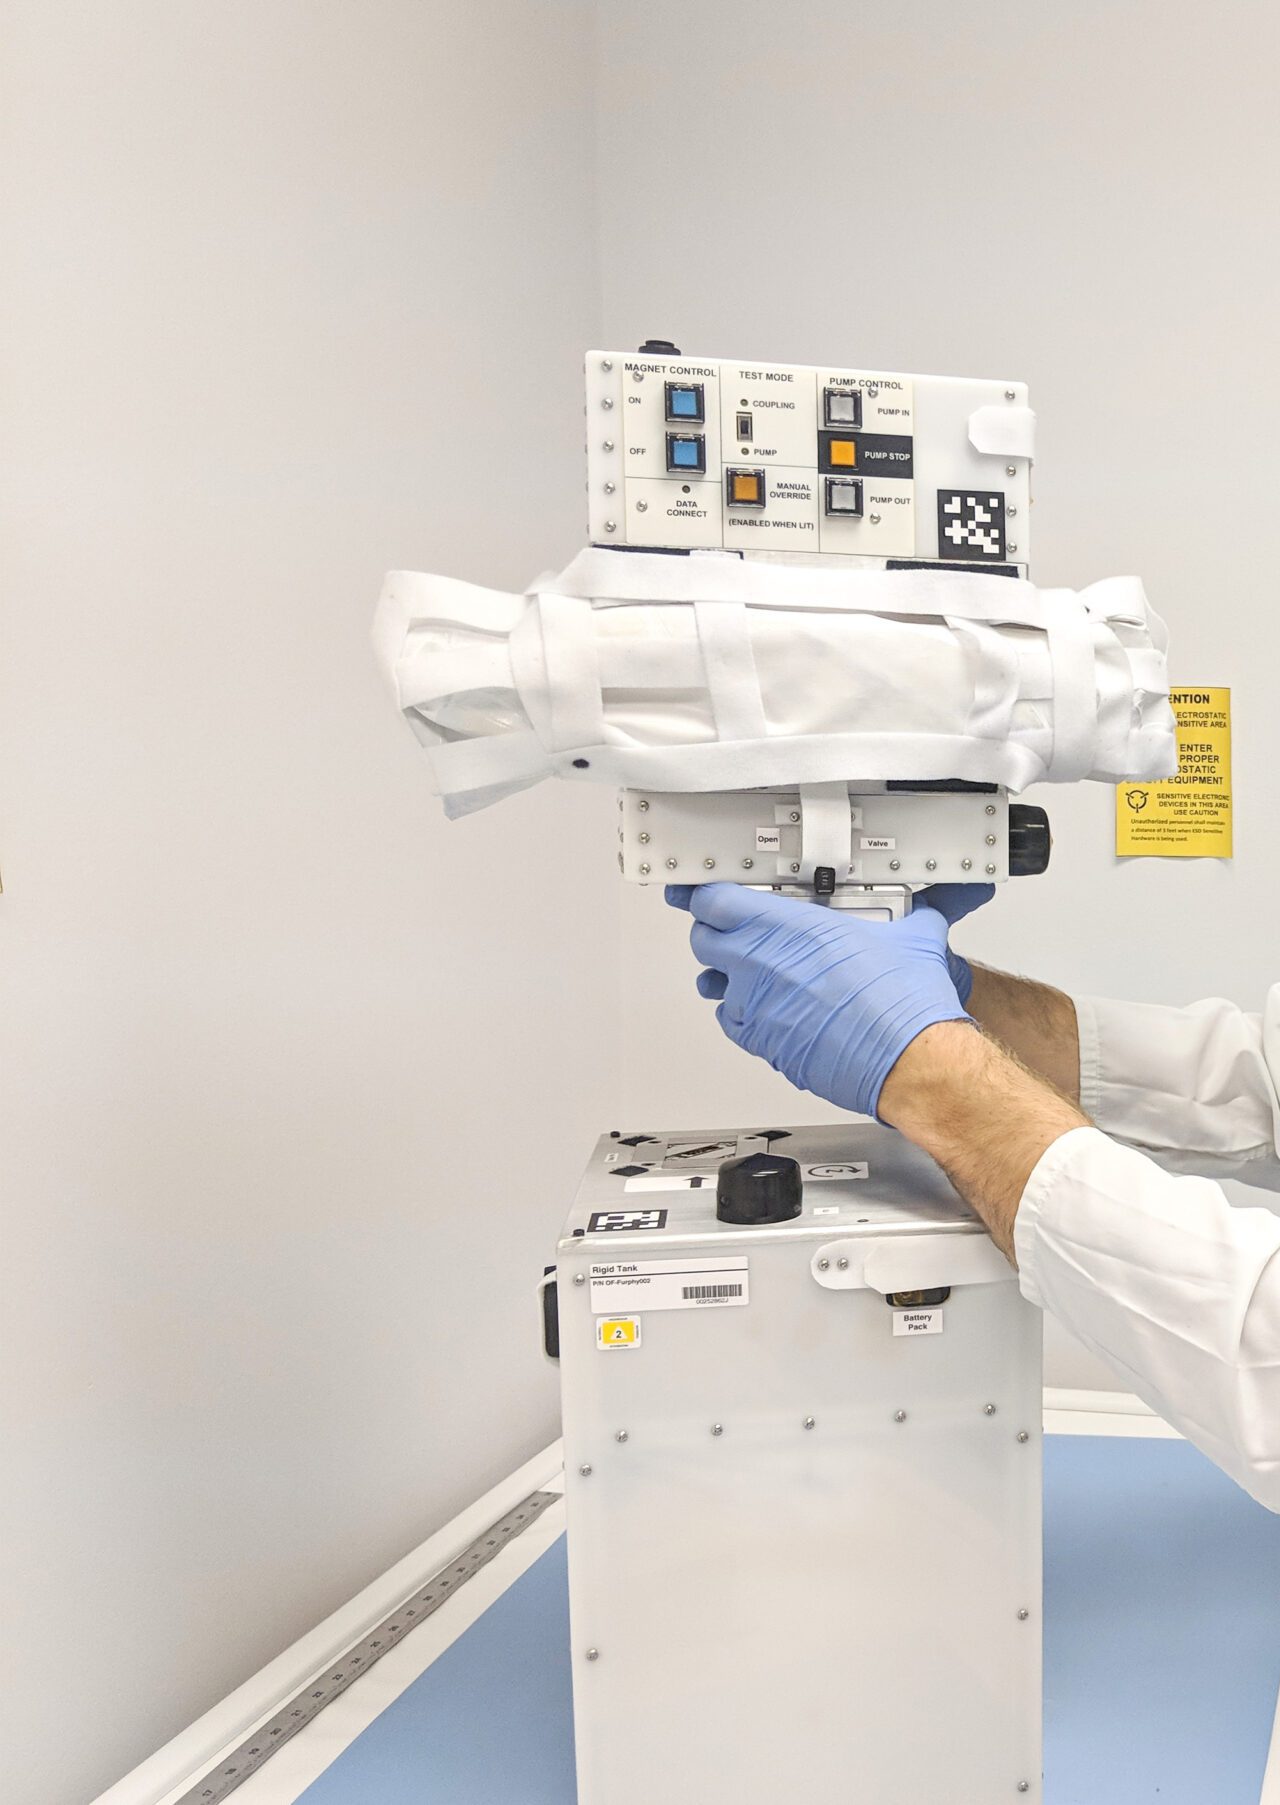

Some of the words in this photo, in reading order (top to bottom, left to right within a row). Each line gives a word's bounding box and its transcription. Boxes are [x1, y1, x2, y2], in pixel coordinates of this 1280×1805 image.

[624, 363, 666, 374] MAGNET
[669, 366, 717, 378] CONTROL
[739, 371, 762, 380] TEST
[766, 373, 794, 382] MODE
[829, 377, 856, 387] PUMP
[858, 379, 904, 390] CONTROL
[628, 396, 641, 404] ON
[752, 400, 795, 410] COUPLING
[877, 407, 900, 416] PUMP
[629, 447, 646, 455] OFF
[753, 448, 777, 456] PUMP
[864, 451, 887, 459] PUMP
[889, 452, 911, 461] STOP
[777, 482, 811, 491] MANUAL
[769, 491, 811, 500] OVERRIDE
[869, 496, 892, 504] PUMP
[676, 500, 698, 508] DATA
[666, 509, 707, 518] CONNECT
[728, 518, 771, 528] (ENABLED
[772, 520, 797, 529] WHEN
[799, 522, 814, 530] LIT)
[1168, 694, 1210, 704] ENTION
[1176, 711, 1227, 719] ECTROSTATIC
[1177, 720, 1208, 728] NSITIVE
[1210, 721, 1227, 729] AREA
[1180, 743, 1212, 752] ENTER
[1179, 755, 1219, 763] PROPER
[1167, 776, 1224, 784] EQUIPMENT
[757, 835, 778, 844] Open
[592, 1266, 615, 1275] Rigid
[616, 1264, 638, 1272] Tank
[903, 1314, 932, 1322] Battery
[908, 1322, 928, 1331] Pack
[615, 1330, 622, 1339] 2
